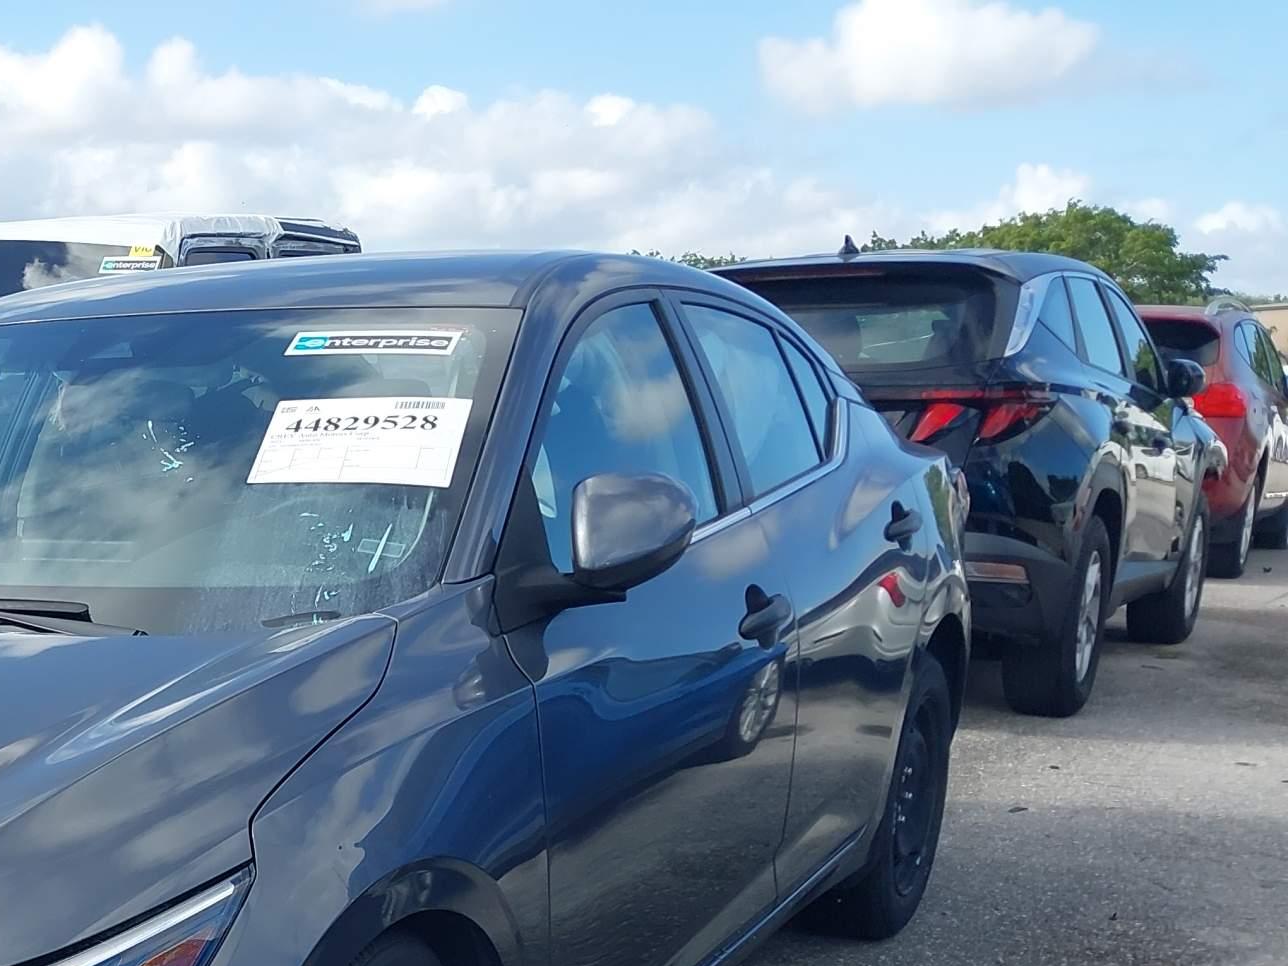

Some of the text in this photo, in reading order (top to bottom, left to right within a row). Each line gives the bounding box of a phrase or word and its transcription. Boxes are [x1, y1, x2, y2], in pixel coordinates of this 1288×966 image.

[104, 260, 156, 270] enterprise
[303, 336, 449, 349] enterprise
[285, 414, 439, 432] 44829528
